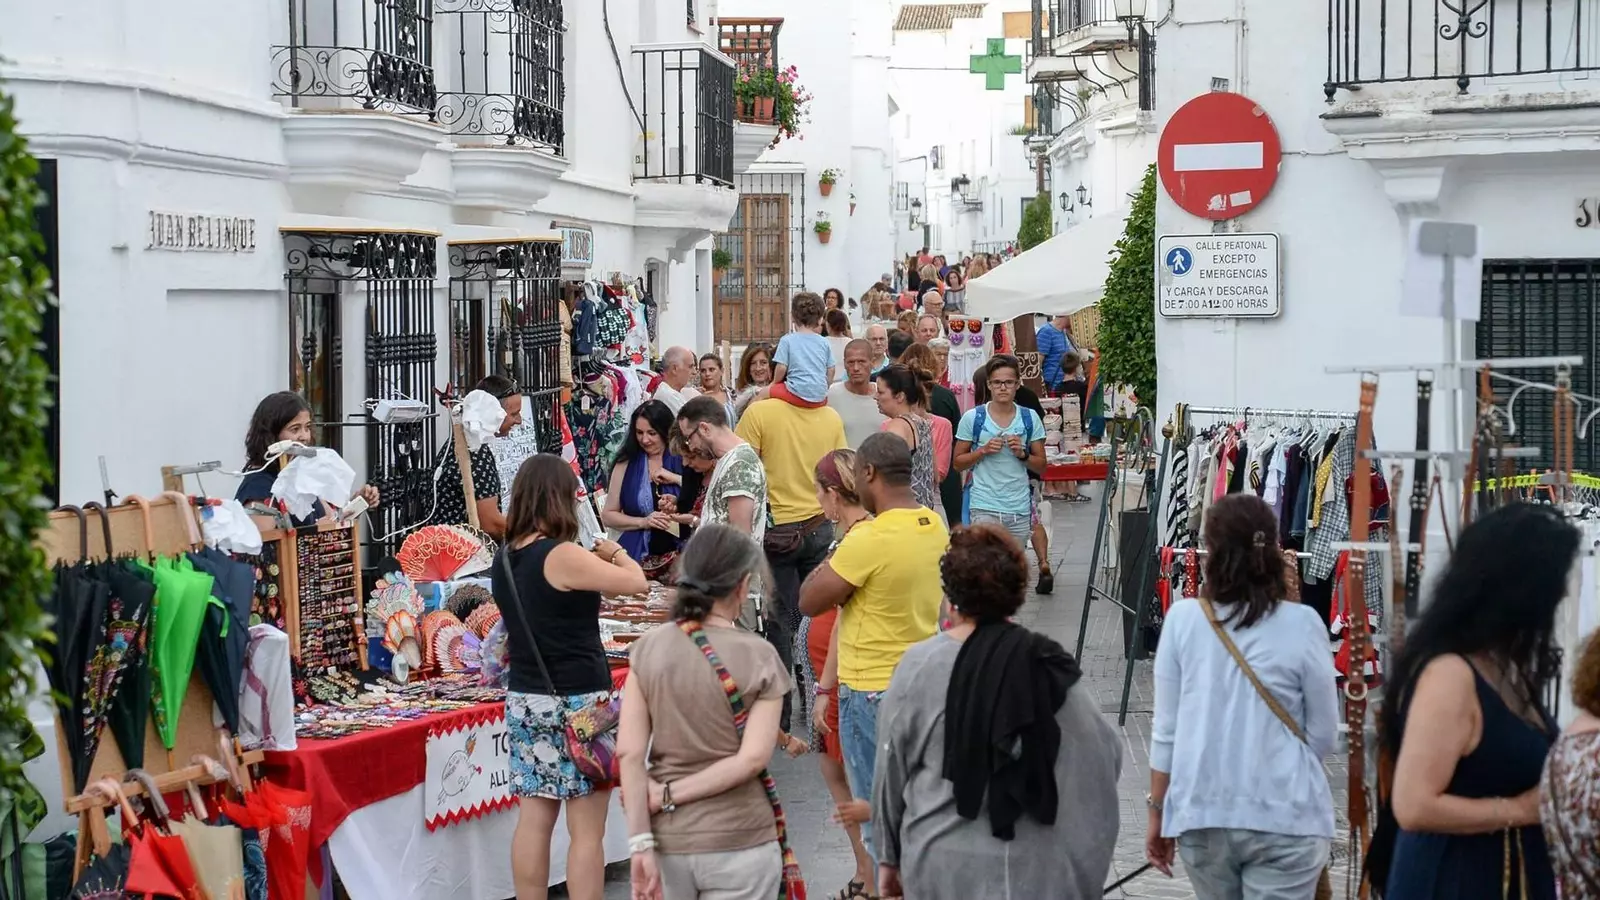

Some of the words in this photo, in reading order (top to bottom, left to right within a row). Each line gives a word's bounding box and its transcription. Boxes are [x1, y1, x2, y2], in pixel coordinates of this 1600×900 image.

[149, 210, 184, 248] JUAN
[188, 214, 256, 252] RELINQUE
[1195, 241, 1222, 250] CALLE
[1224, 241, 1268, 250] PEATONAL
[1213, 254, 1256, 264] EXCEPTO
[1200, 269, 1268, 279] EMERGENCIAS
[1166, 287, 1172, 296] Y
[1174, 287, 1206, 296] CARGA
[1208, 286, 1214, 296] Y
[1216, 286, 1269, 296] DESCARGA
[1164, 300, 1176, 309] DE
[1178, 300, 1200, 309] 7:00
[1236, 299, 1268, 308] HORAS
